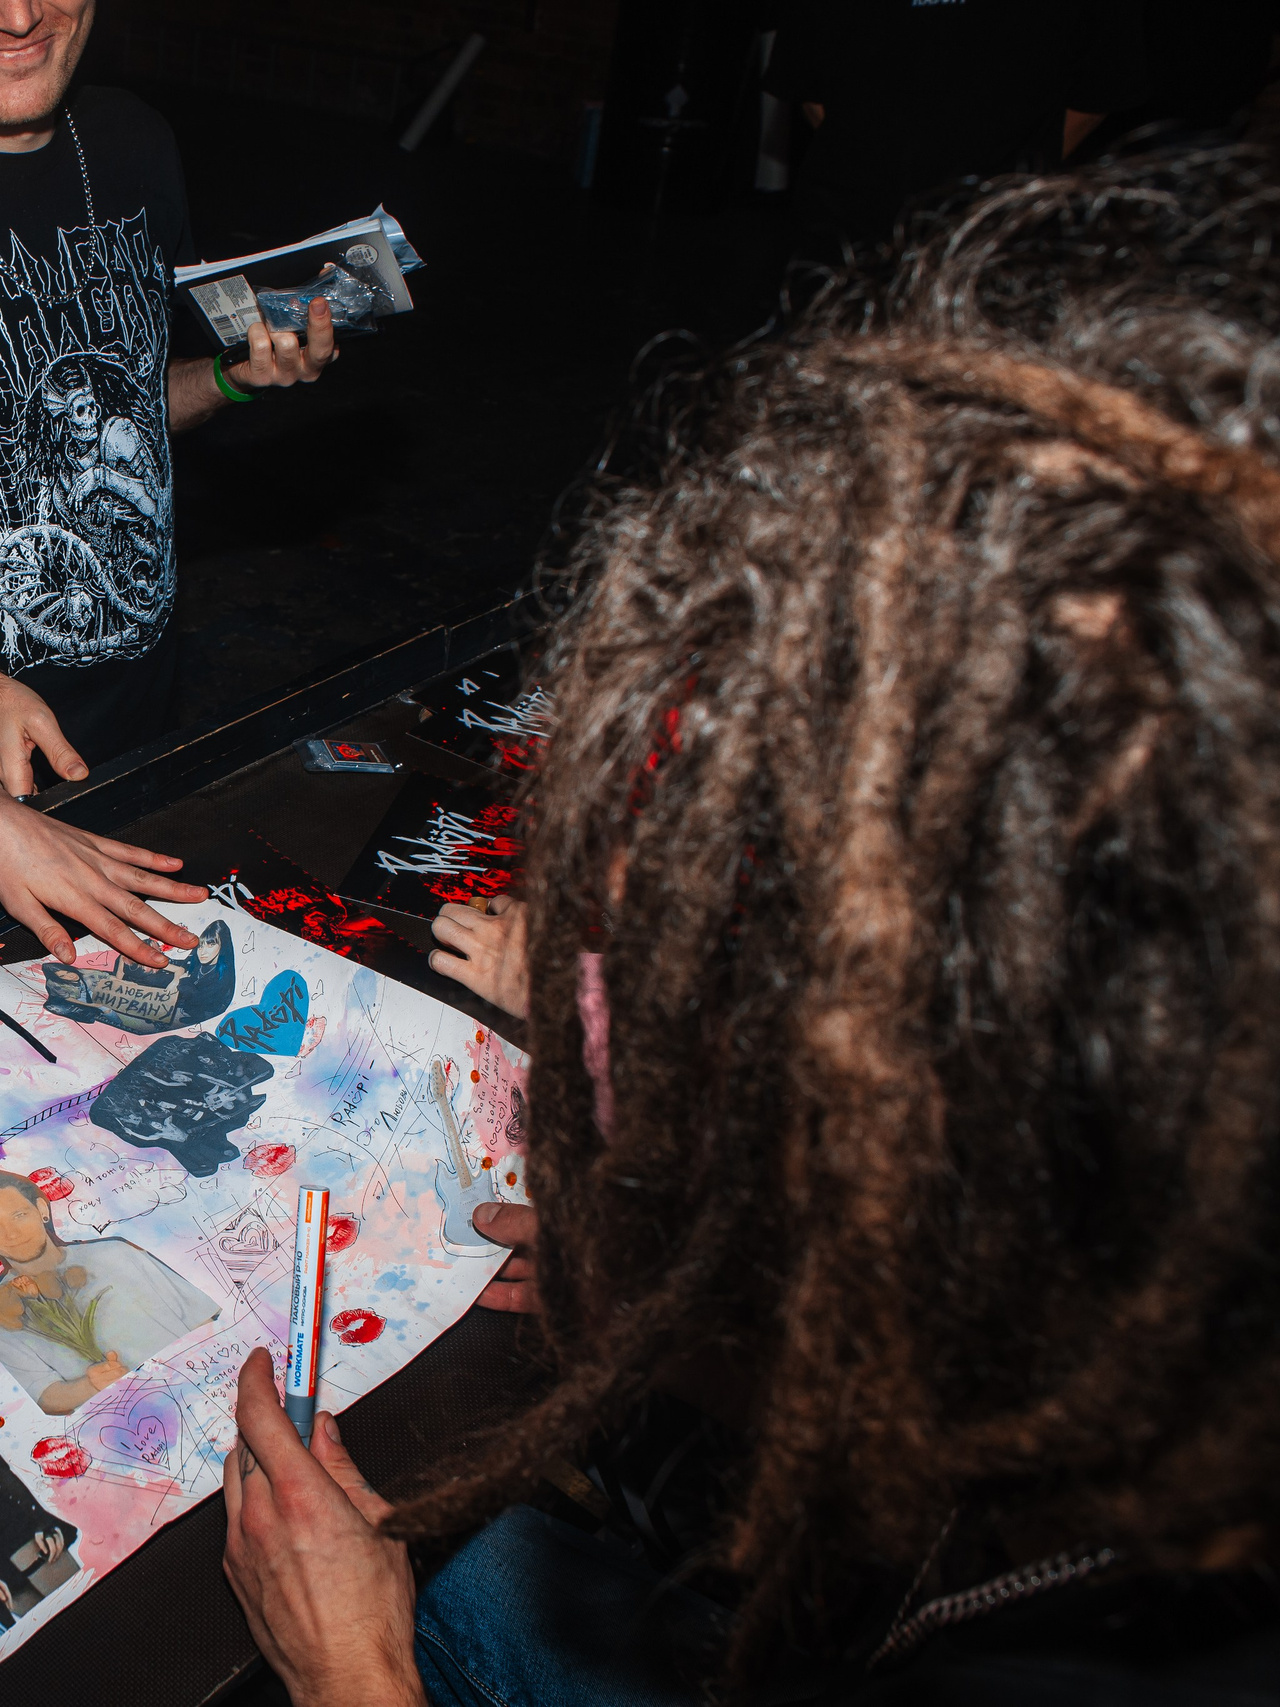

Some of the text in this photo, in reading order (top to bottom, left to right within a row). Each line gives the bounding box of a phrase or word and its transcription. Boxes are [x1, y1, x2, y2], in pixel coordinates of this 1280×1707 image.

[101, 980, 113, 991] Я
[95, 991, 174, 1020] НИРВАНУ
[84, 1176, 95, 1187] Я
[78, 1196, 102, 1213] хочу
[290, 1271, 302, 1326] ЛАКОВЫЙ
[293, 1332, 305, 1388] WORKMATE
[204, 1364, 239, 1385] Самое
[134, 1424, 157, 1451] Love
